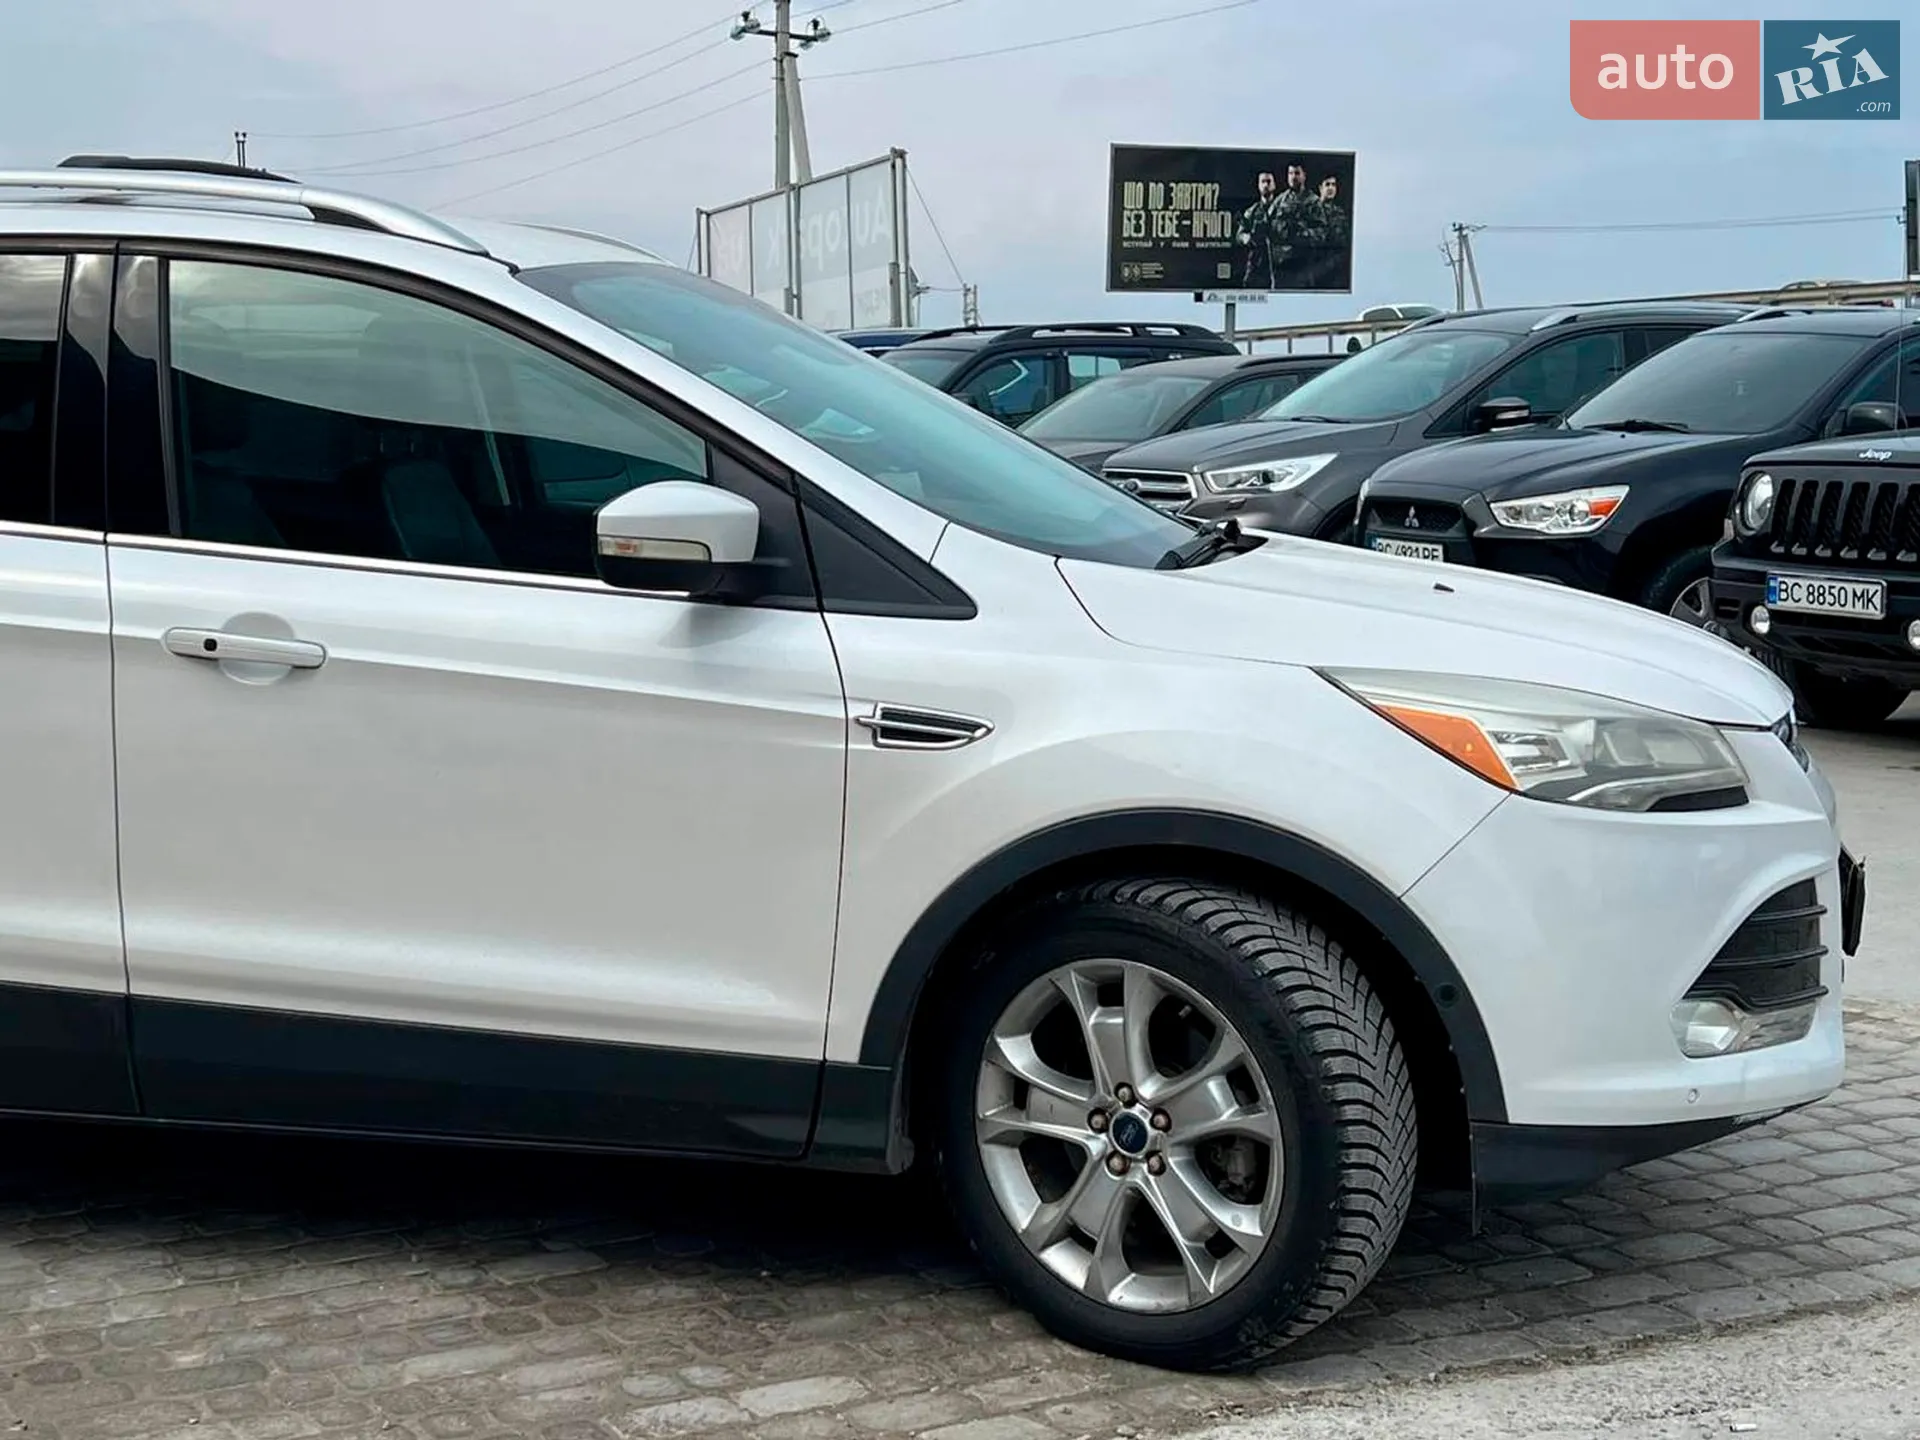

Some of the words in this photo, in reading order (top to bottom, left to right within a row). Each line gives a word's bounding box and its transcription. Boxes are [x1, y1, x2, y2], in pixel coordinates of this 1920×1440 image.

[1148, 182, 1164, 209] ПО
[1169, 182, 1220, 210] ЗАВТРА?
[1123, 210, 1146, 238] БЕЗ
[1151, 211, 1181, 238] ТЕБЕ
[1192, 211, 1232, 238] НІЧОГО
[1859, 447, 1892, 461] Jeep
[1779, 580, 1802, 603] BC
[1806, 583, 1848, 607] 8850
[1852, 587, 1879, 611] MK
